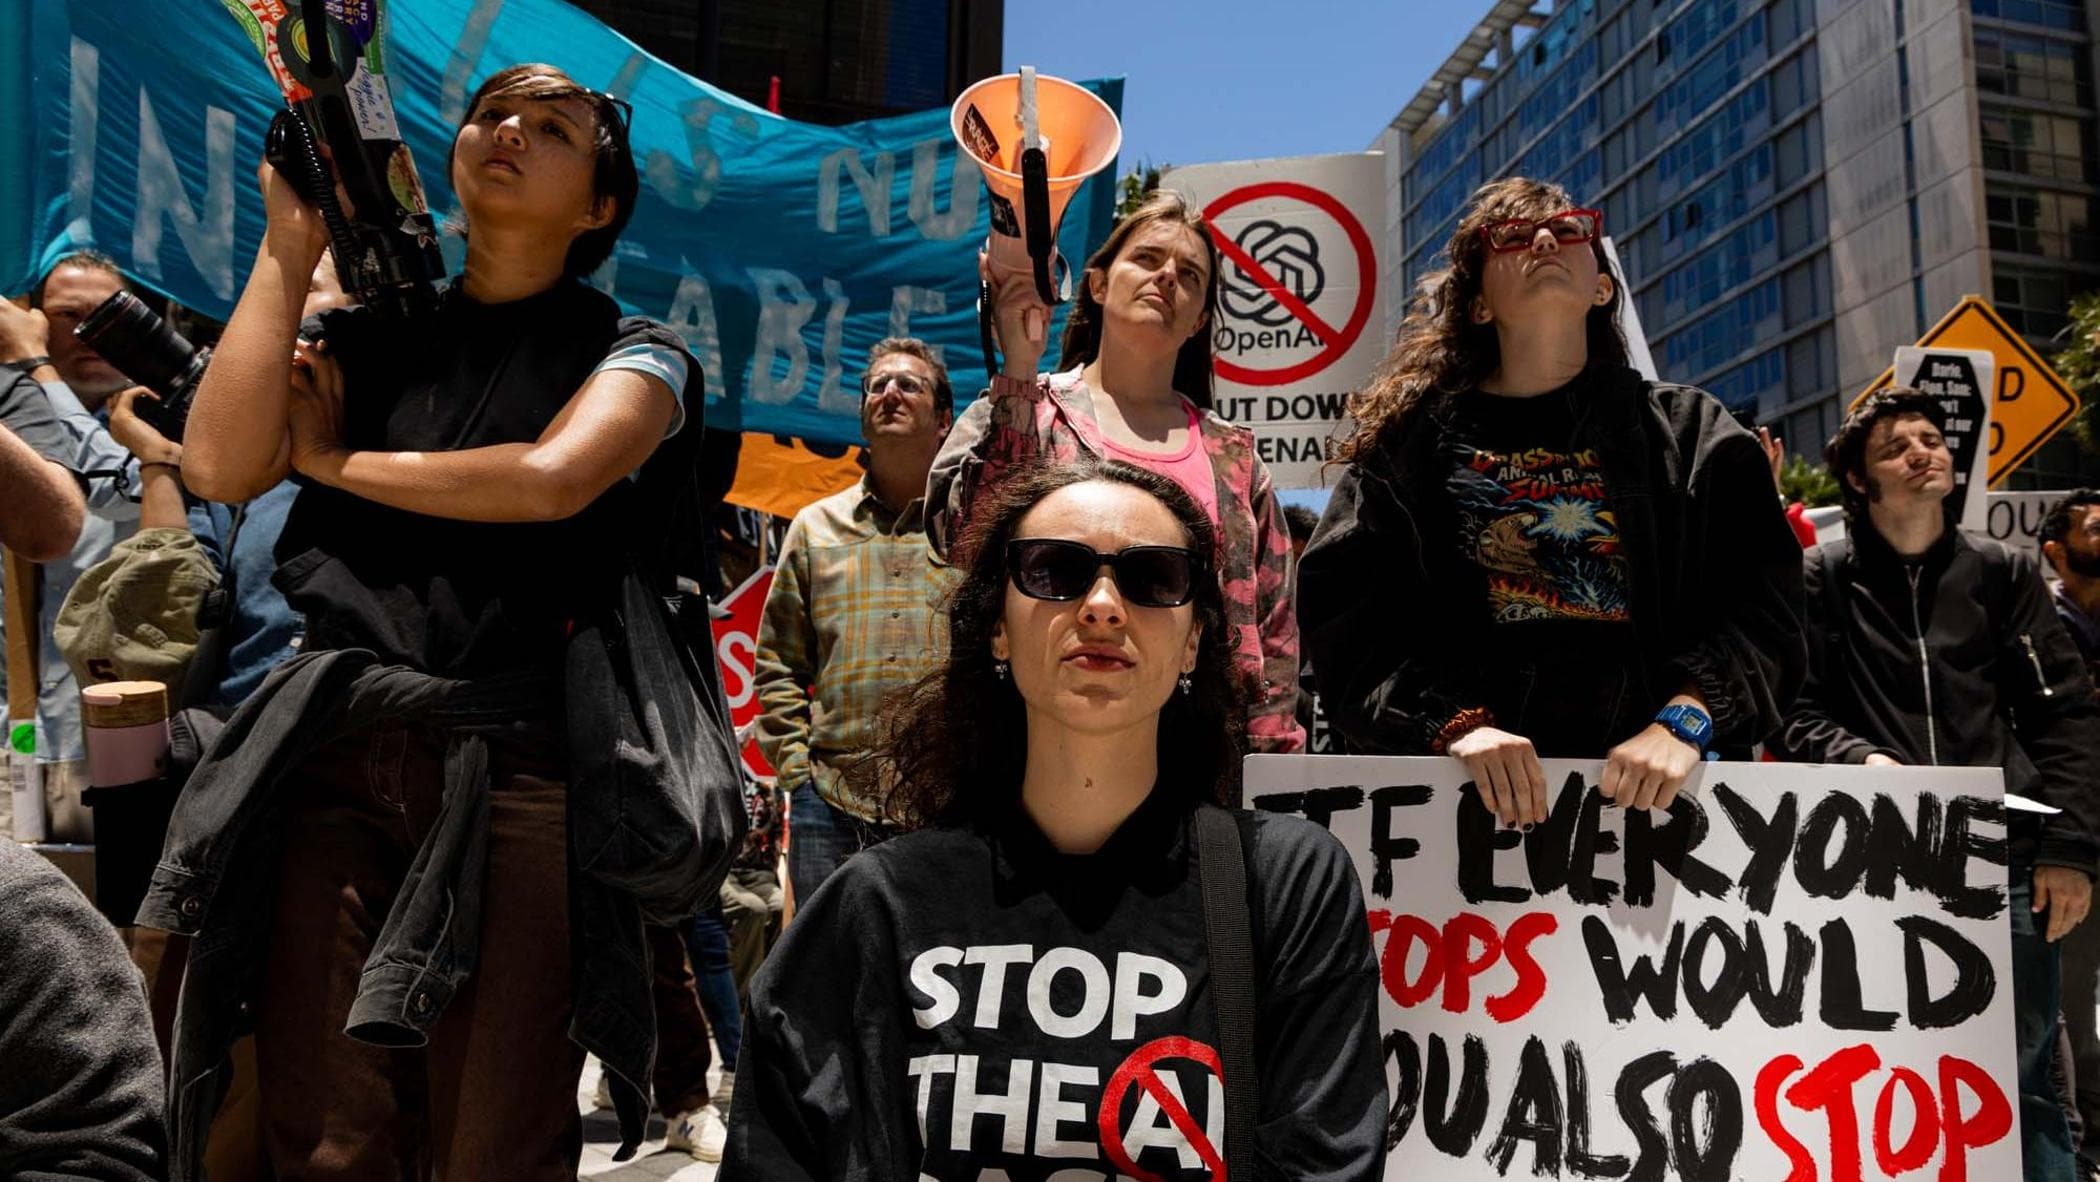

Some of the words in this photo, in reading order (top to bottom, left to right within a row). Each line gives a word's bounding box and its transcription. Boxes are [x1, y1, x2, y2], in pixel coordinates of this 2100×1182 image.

[1457, 770, 2009, 920] EVERYONE
[909, 944, 1188, 1041] STOP
[1368, 909, 1559, 1024] OPS
[1582, 914, 1998, 1031] WOULD
[906, 1053, 1100, 1160] THE
[1381, 1028, 1491, 1158] OU
[1484, 1033, 1744, 1182] ALSO
[1753, 1043, 2014, 1182] STOP
